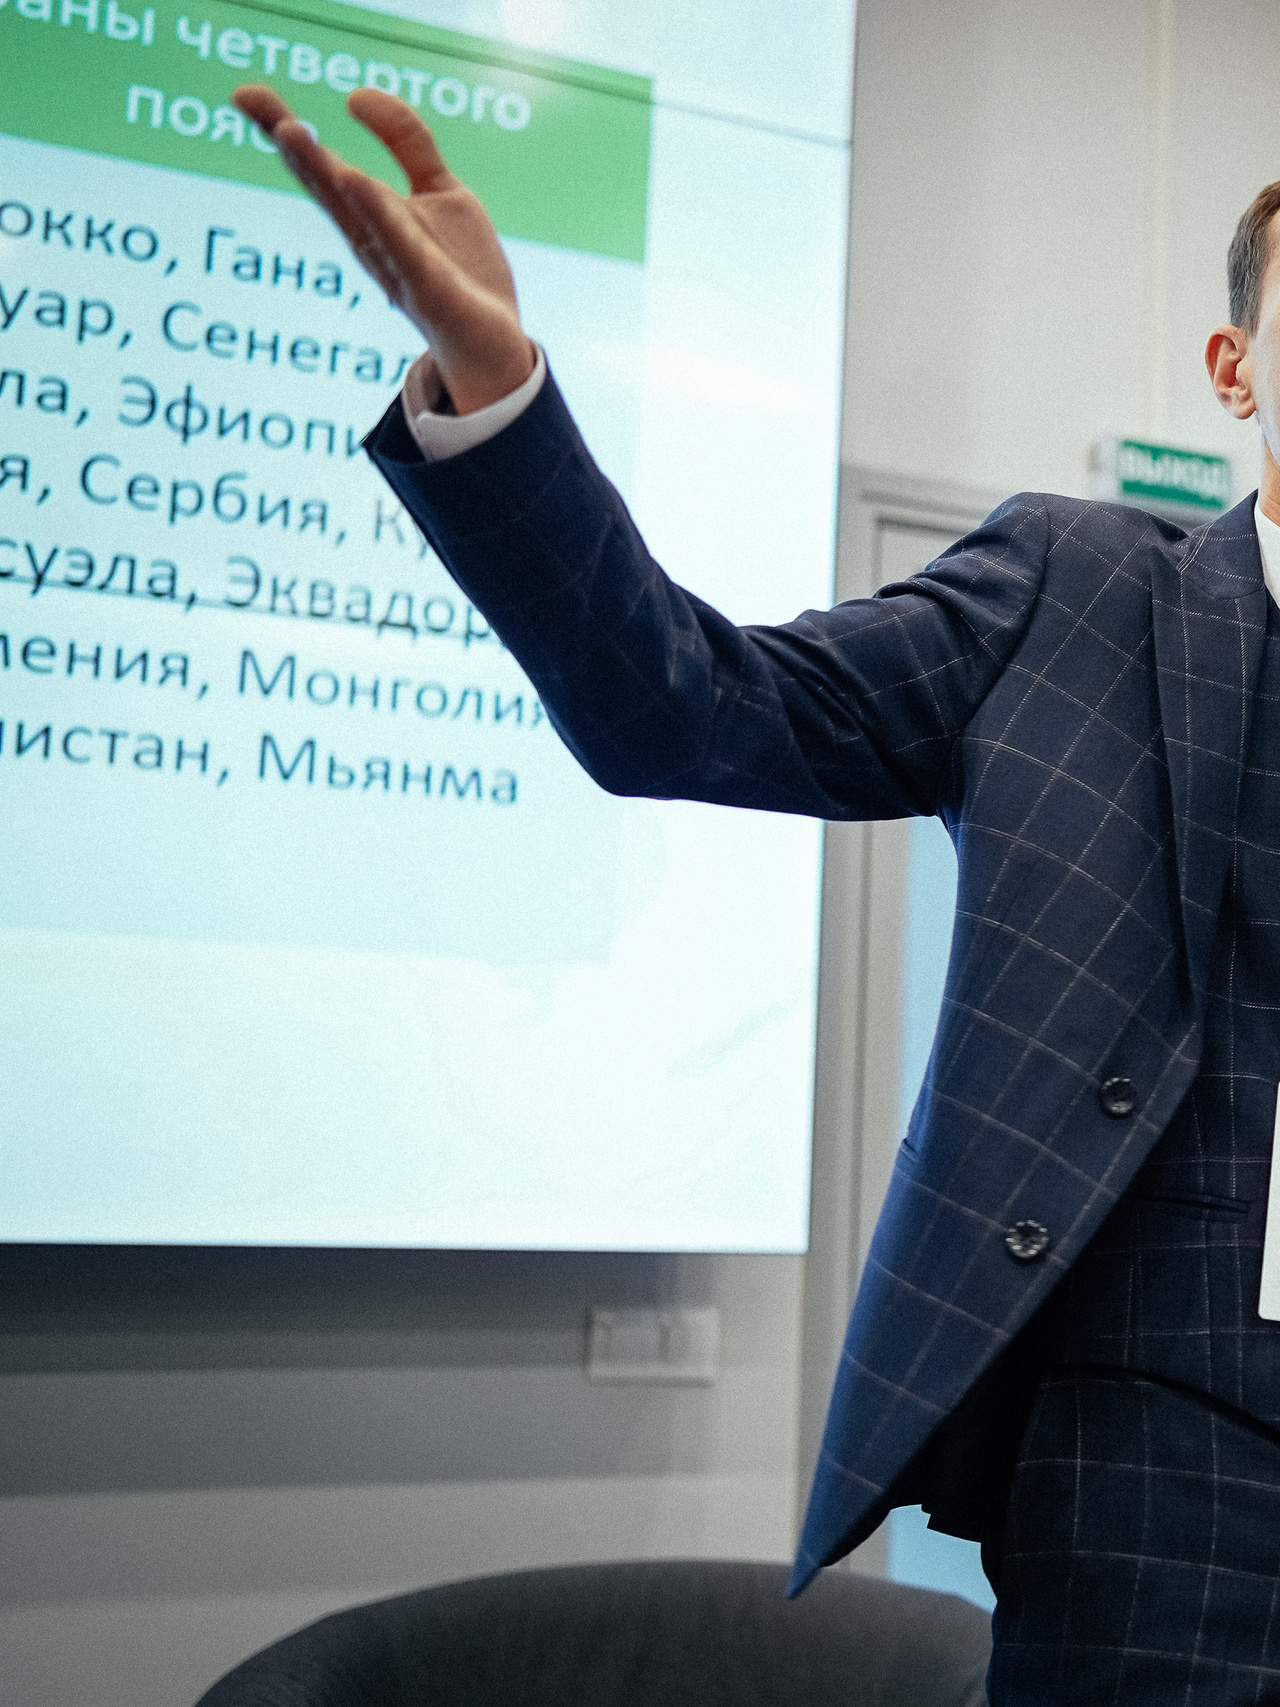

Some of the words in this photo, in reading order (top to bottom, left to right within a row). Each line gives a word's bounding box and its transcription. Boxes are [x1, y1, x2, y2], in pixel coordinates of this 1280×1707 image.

[0, 0, 156, 46] аны
[176, 15, 532, 131] четвертого
[125, 83, 319, 153] пояс
[202, 224, 362, 311] Гана,
[80, 453, 346, 546] Сербия,
[0, 632, 209, 699] ения,
[0, 717, 230, 787] истан,
[257, 731, 518, 804] Мьянма
